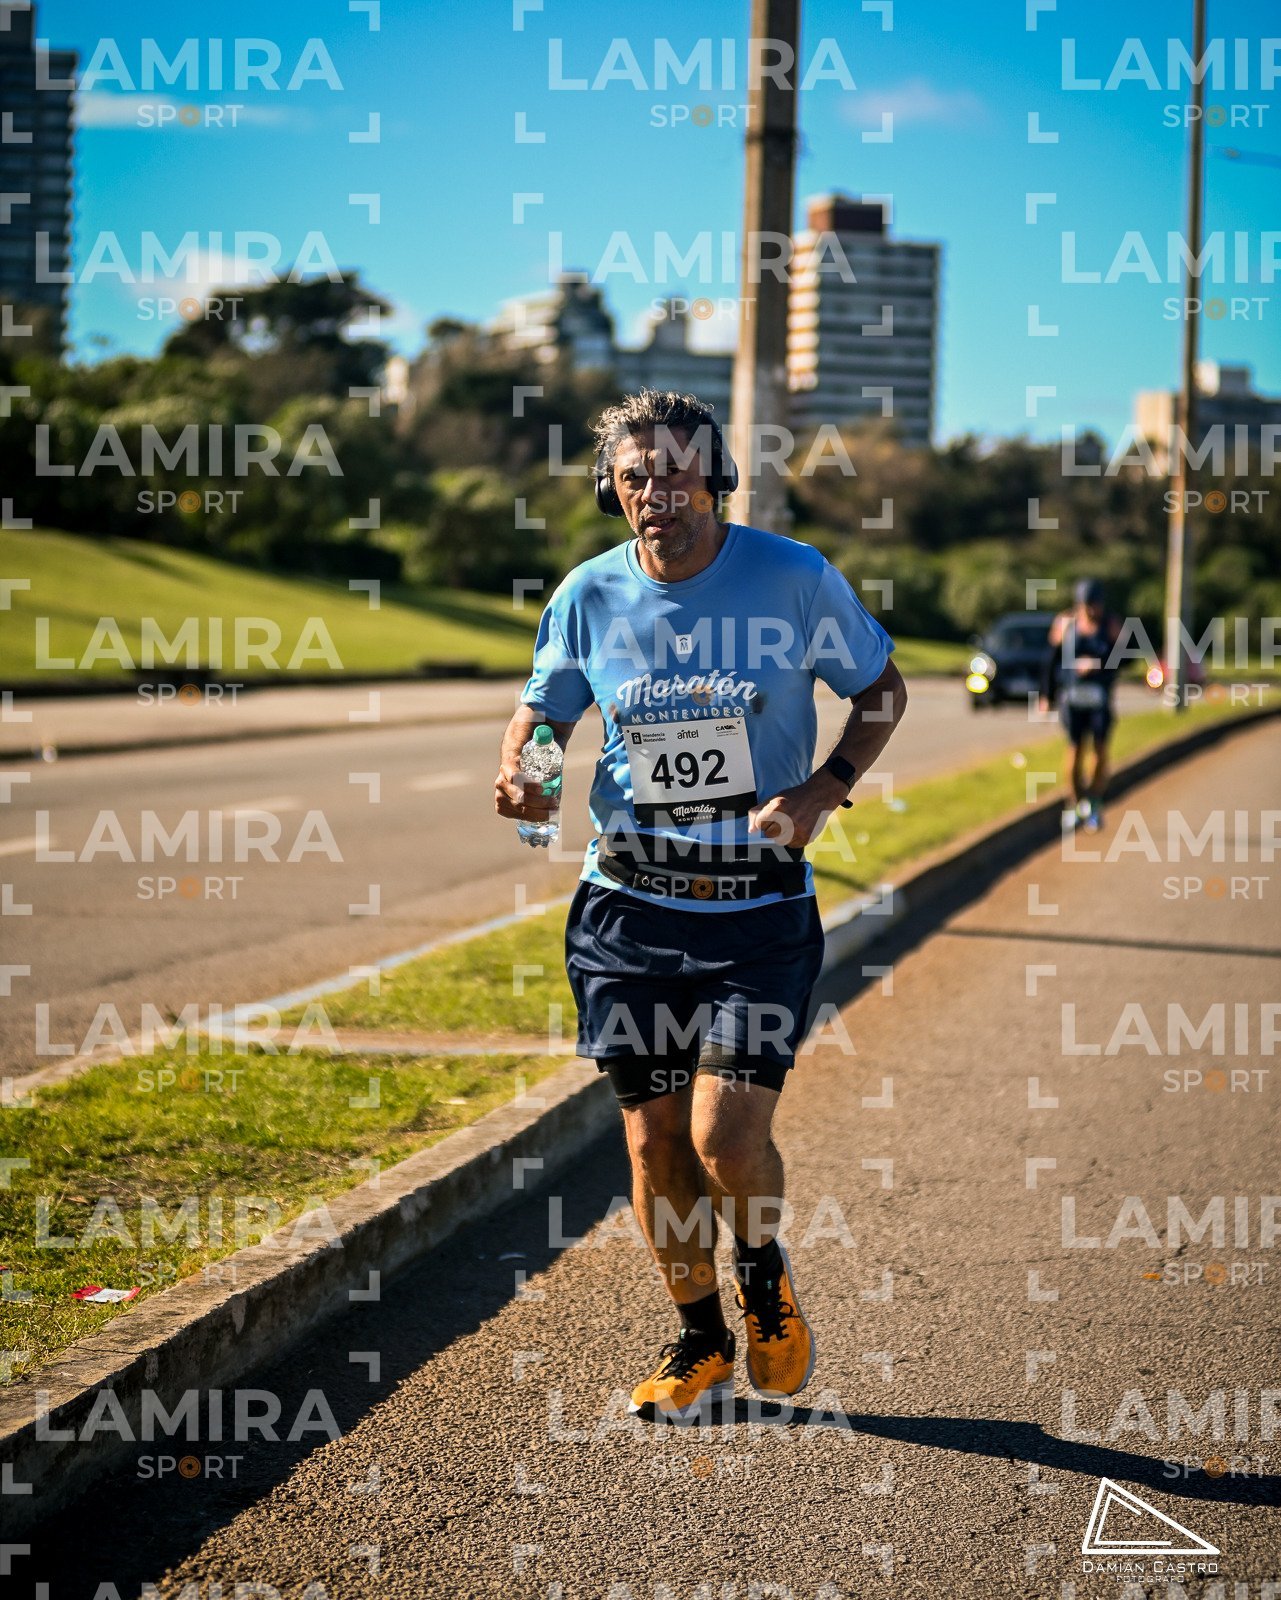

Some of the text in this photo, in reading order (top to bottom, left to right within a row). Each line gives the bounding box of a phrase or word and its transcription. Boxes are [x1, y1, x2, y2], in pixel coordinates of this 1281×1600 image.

[615, 669, 758, 708] Maratón
[631, 706, 745, 724] MONTEVIDEO
[677, 729, 699, 740] antel
[651, 749, 729, 789] 492
[672, 804, 717, 817] Maratón
